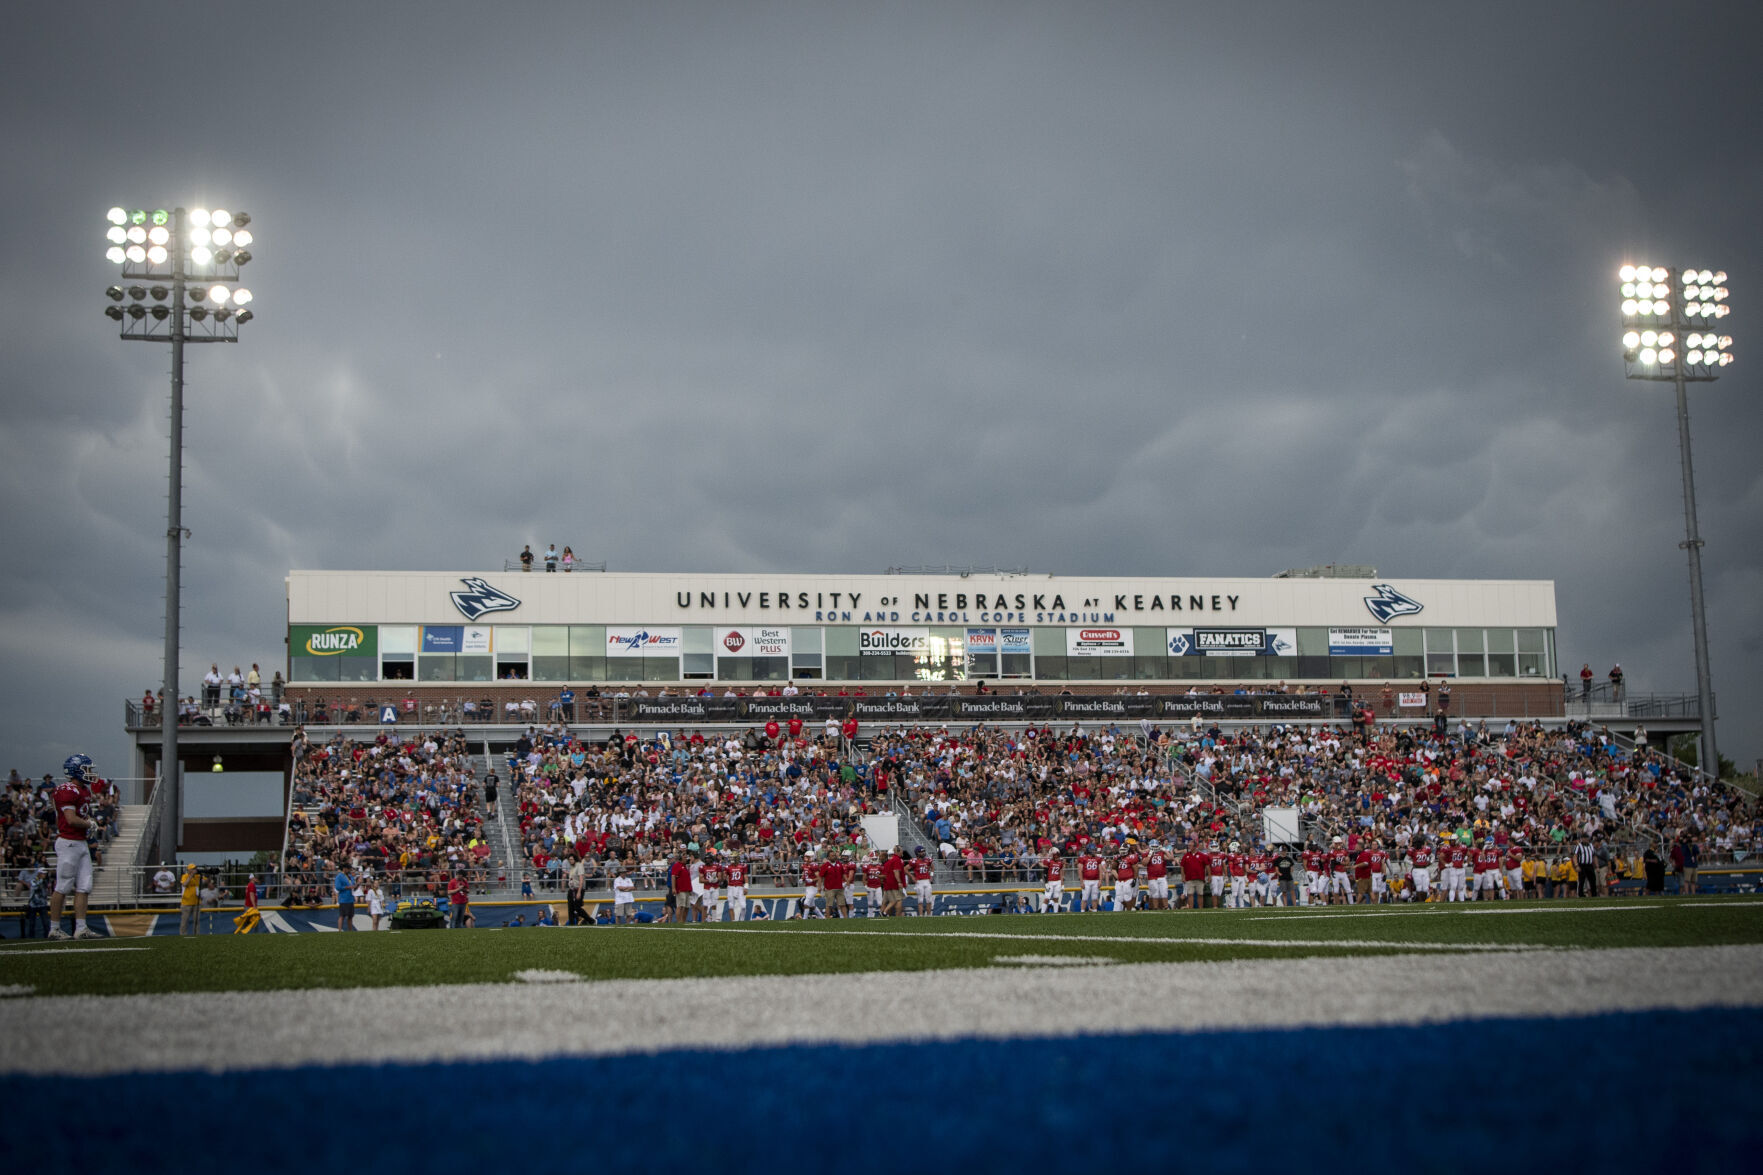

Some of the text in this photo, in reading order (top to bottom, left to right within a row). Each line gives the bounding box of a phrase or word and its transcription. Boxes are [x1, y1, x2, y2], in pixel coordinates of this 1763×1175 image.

[677, 591, 1239, 612] UNIVERSITY OF NEBRASKA AT KEARNEY
[815, 611, 1115, 623] RON AND CAROL COPE STADIUM
[761, 629, 779, 637] Best
[311, 633, 358, 649] RUNZA
[726, 637, 742, 647] BW
[970, 634, 994, 643] KRVN
[1199, 633, 1260, 645] FANATICS
[760, 645, 781, 653] PLUS
[639, 703, 705, 714] Pinnacle Bank
[749, 703, 814, 713] Pinnacle Bank
[856, 702, 896, 713] Pinnacle
[896, 702, 920, 712] Bank
[961, 701, 1001, 712] Pinnacle
[1001, 701, 1024, 711] Bank
[1064, 701, 1102, 711] Pinnacle
[1102, 701, 1125, 711] Bank
[1165, 700, 1202, 711] Pinnacle
[1202, 700, 1224, 711] Bank
[1263, 700, 1321, 710] Pinnacle Bank
[382, 707, 396, 722] A
[1151, 855, 1162, 865] 68
[1416, 853, 1427, 864] 20
[1051, 866, 1061, 875] 12
[1086, 861, 1098, 871] 66
